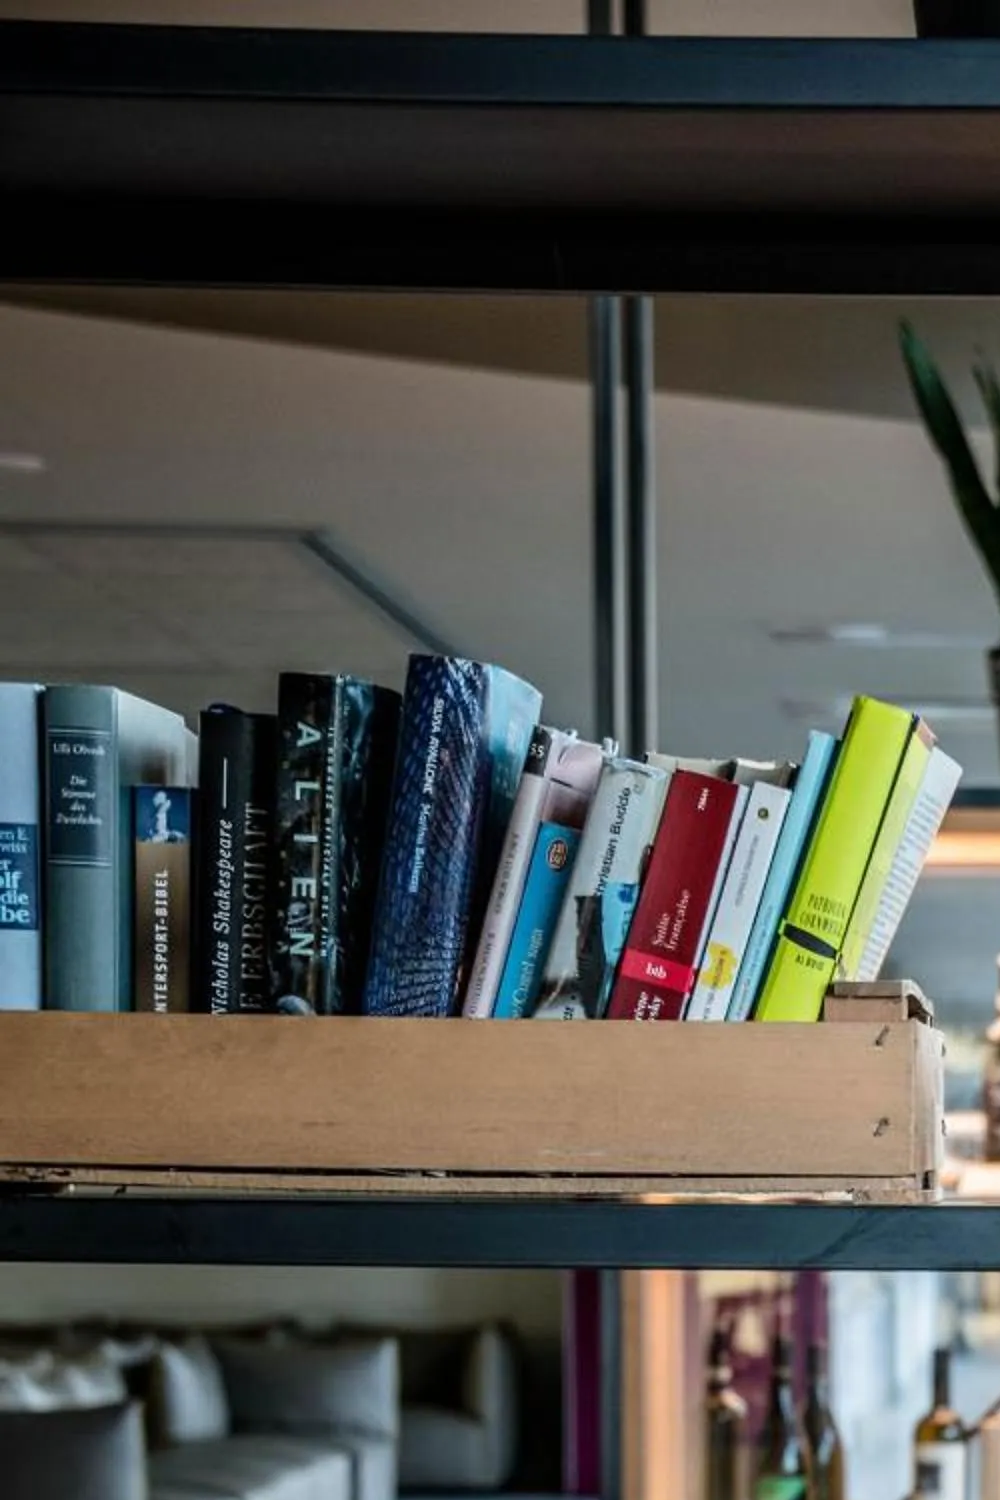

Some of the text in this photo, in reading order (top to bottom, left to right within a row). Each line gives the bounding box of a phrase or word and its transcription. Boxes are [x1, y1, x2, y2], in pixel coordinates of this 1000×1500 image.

[211, 819, 235, 1015] Nicholas Shakespeare
[240, 802, 268, 980] ERBSCHAFT
[289, 720, 322, 959] ALIEN
[593, 838, 619, 897] hristian
